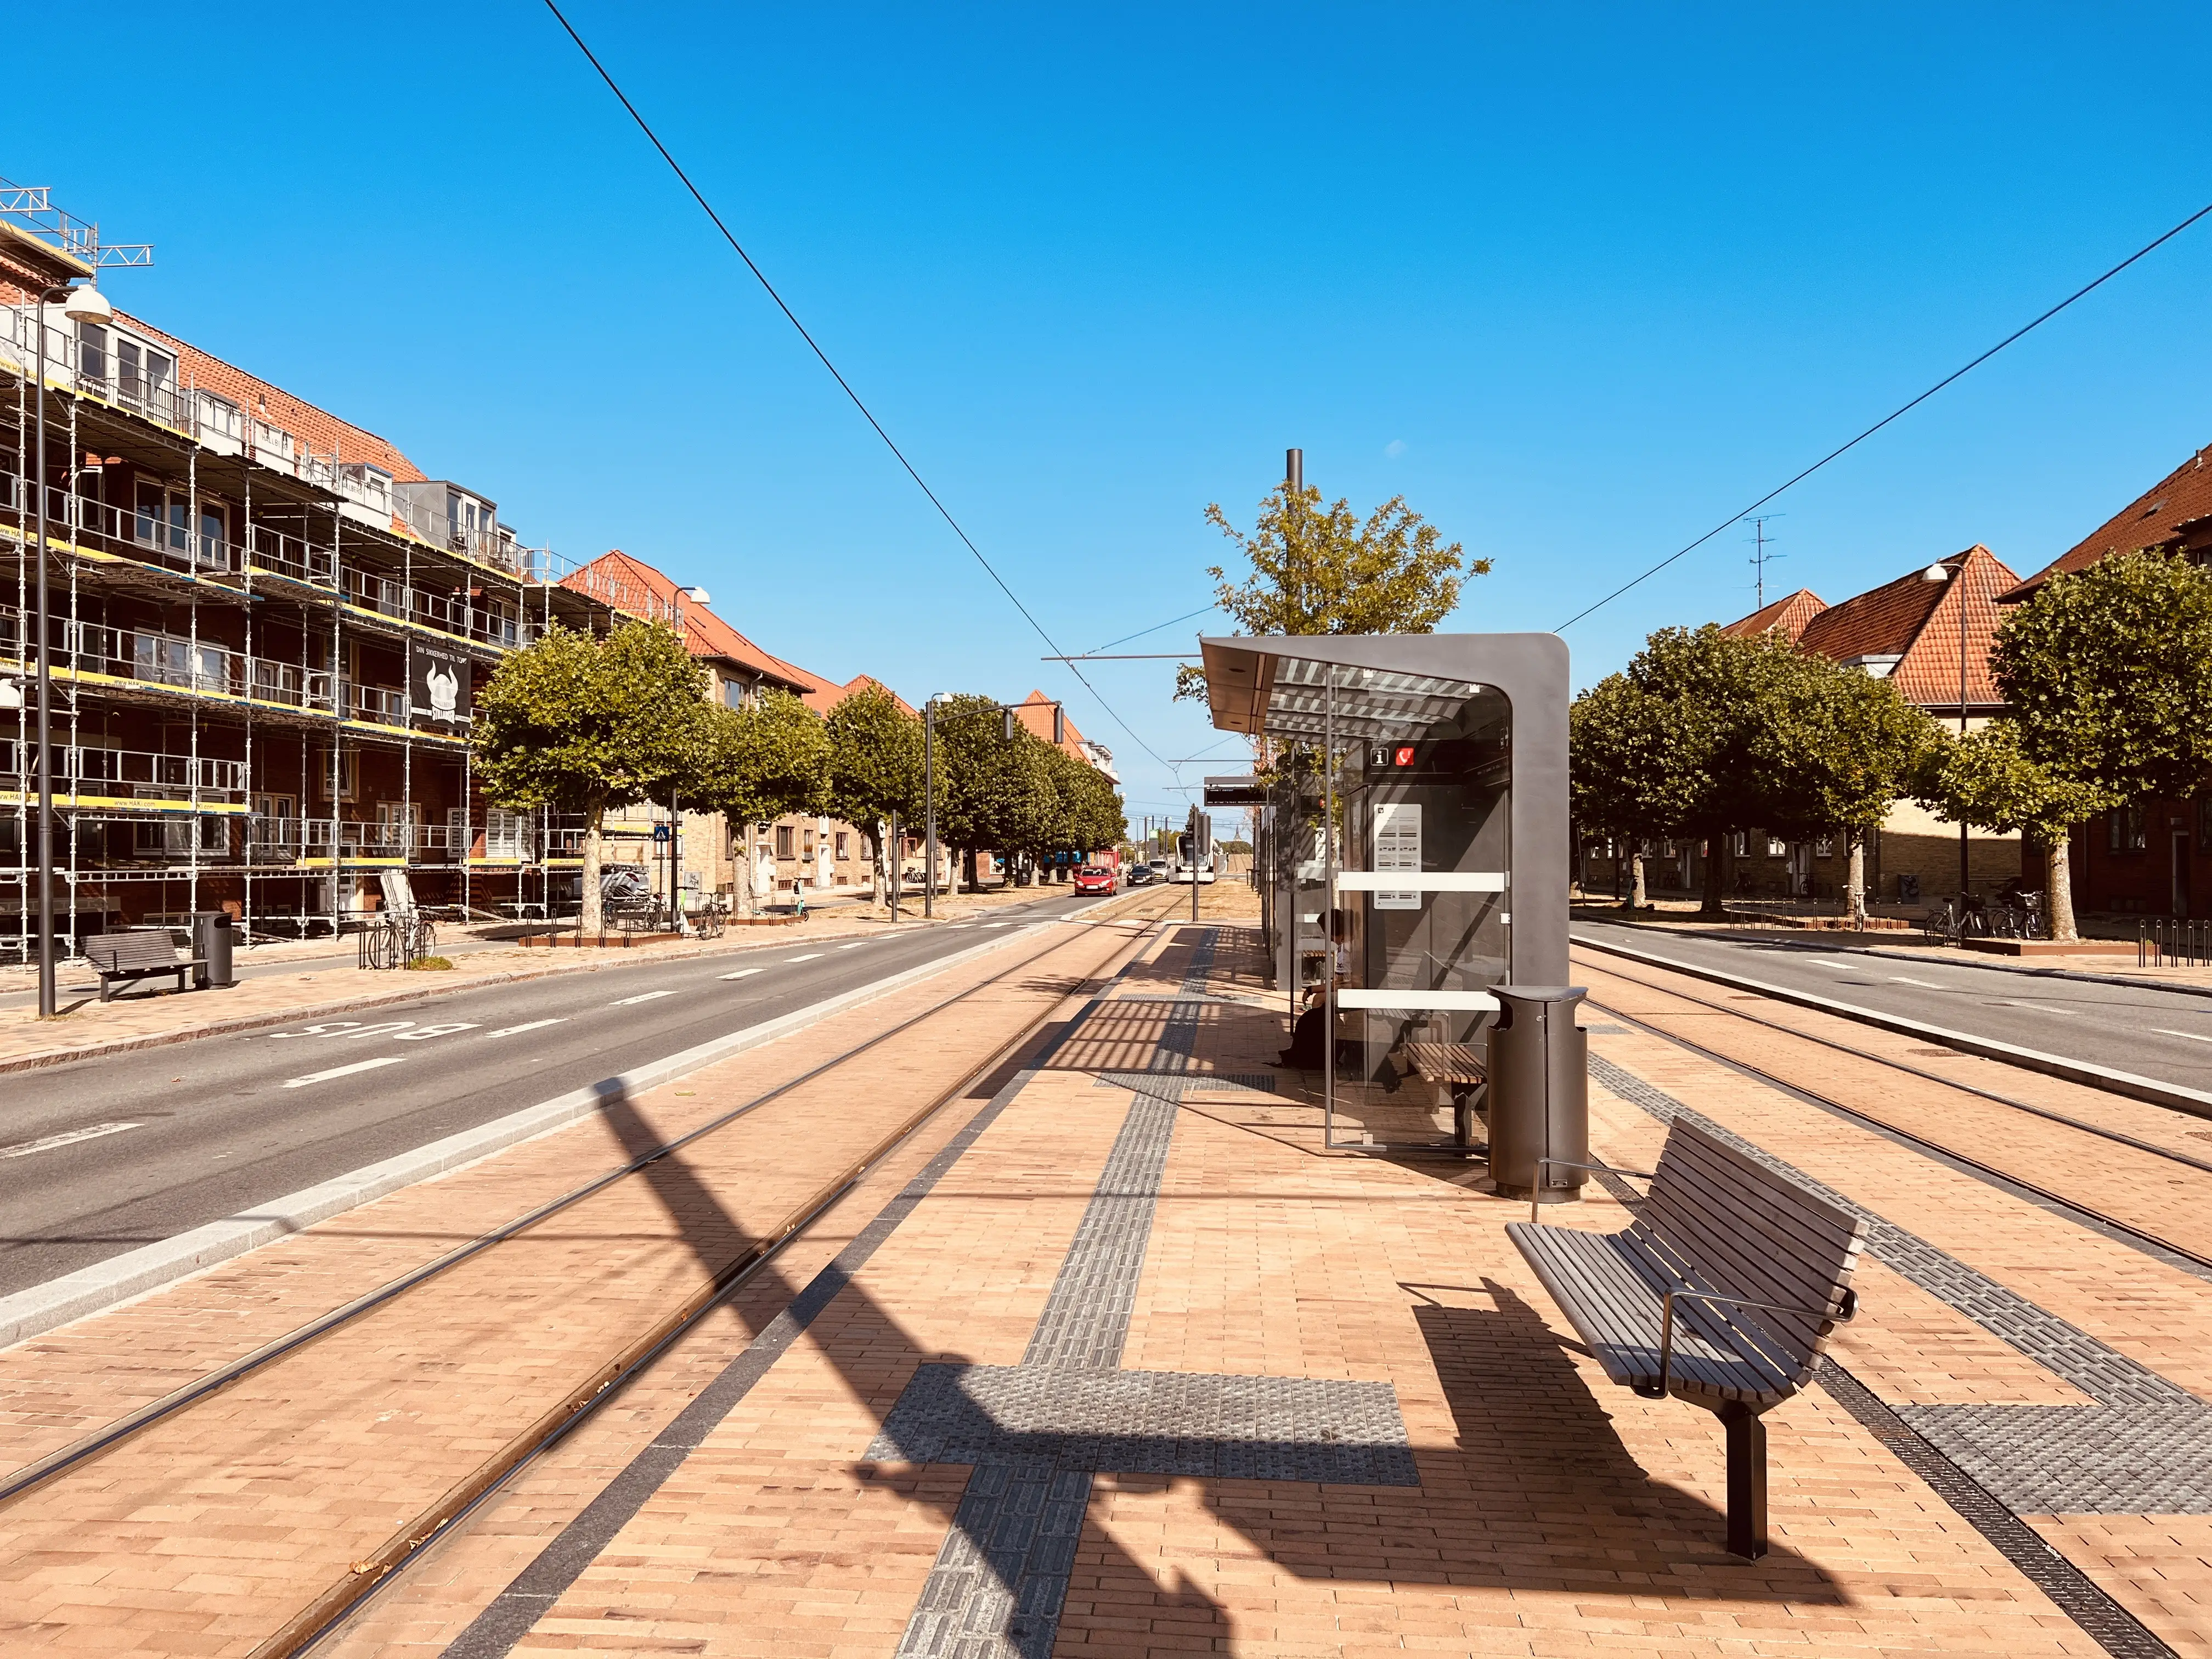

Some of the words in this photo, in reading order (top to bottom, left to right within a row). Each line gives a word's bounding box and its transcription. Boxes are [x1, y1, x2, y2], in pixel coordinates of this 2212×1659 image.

[416, 646, 425, 654] DIN
[426, 648, 448, 660] SIKKERHED
[269, 1021, 483, 1040] BUS
